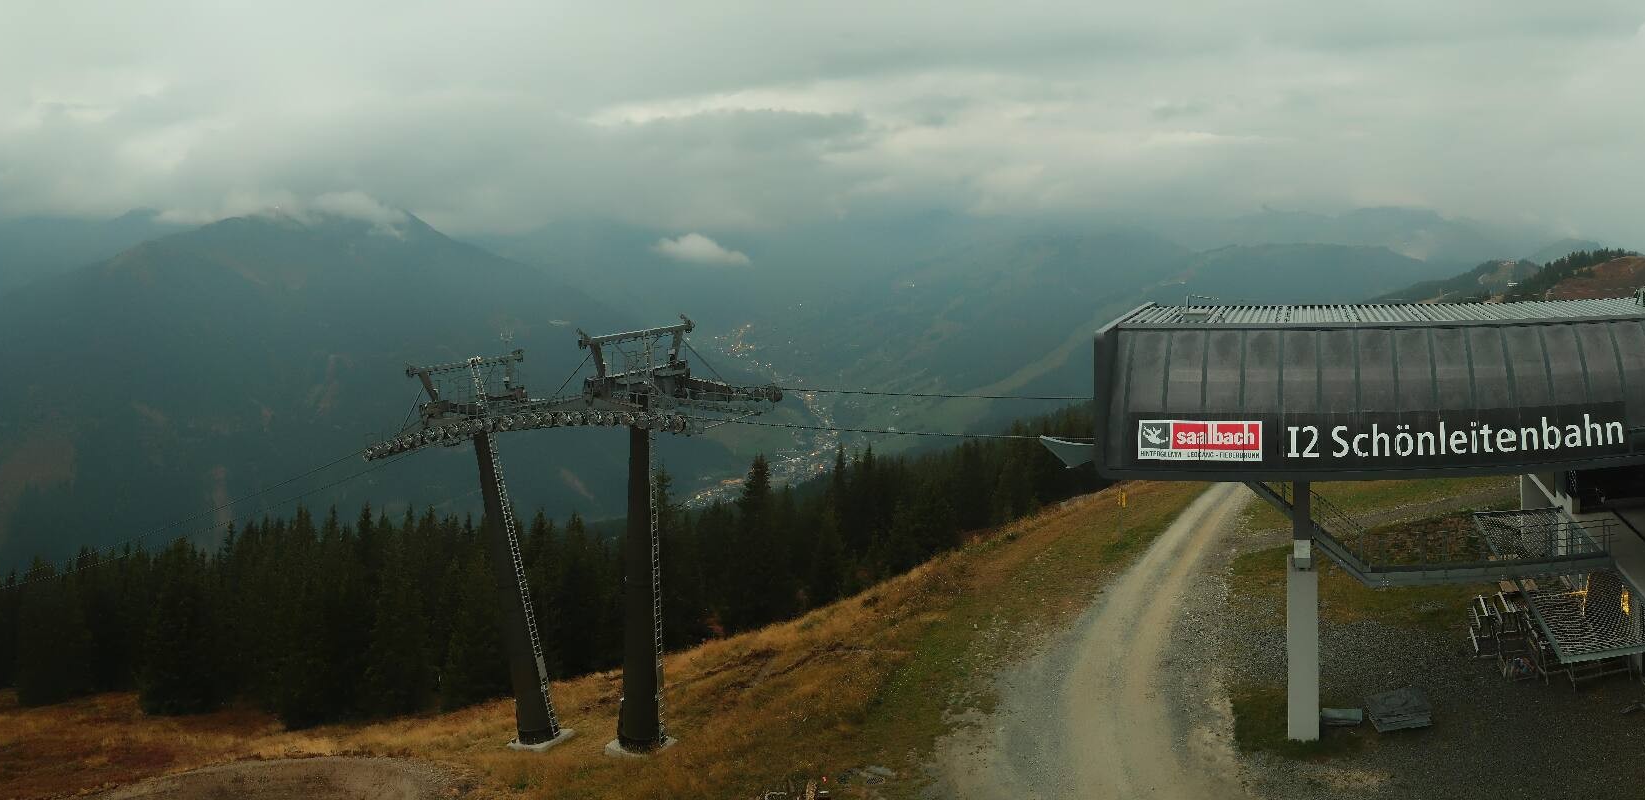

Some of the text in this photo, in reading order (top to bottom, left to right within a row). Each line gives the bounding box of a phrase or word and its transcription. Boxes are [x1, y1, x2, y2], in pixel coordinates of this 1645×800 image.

[1176, 422, 1256, 446] saalbach
[1287, 413, 1625, 458] I2 Schönleitenbahn
